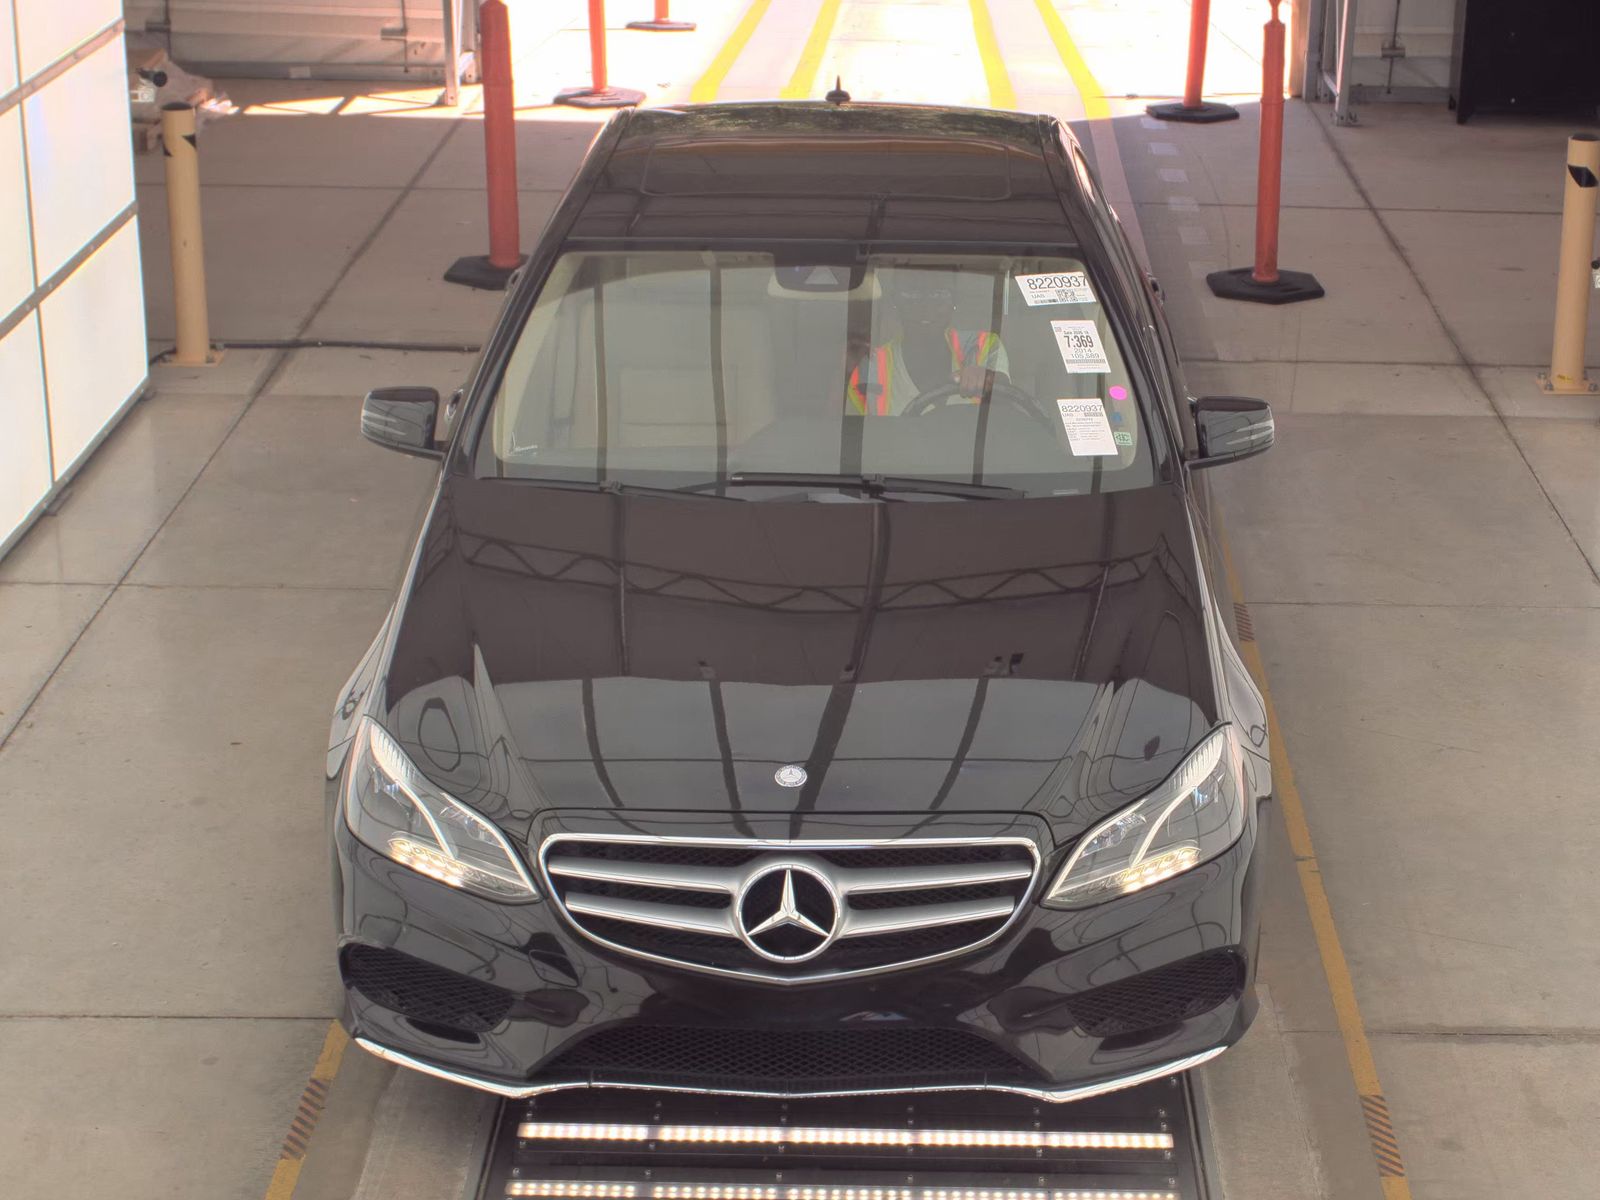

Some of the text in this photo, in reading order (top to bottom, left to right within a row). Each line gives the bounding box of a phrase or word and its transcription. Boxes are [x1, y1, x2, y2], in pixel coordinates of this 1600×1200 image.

[1027, 275, 1086, 290] 8220937
[1063, 335, 1094, 348] 7:369
[1061, 404, 1103, 413] 8220937
